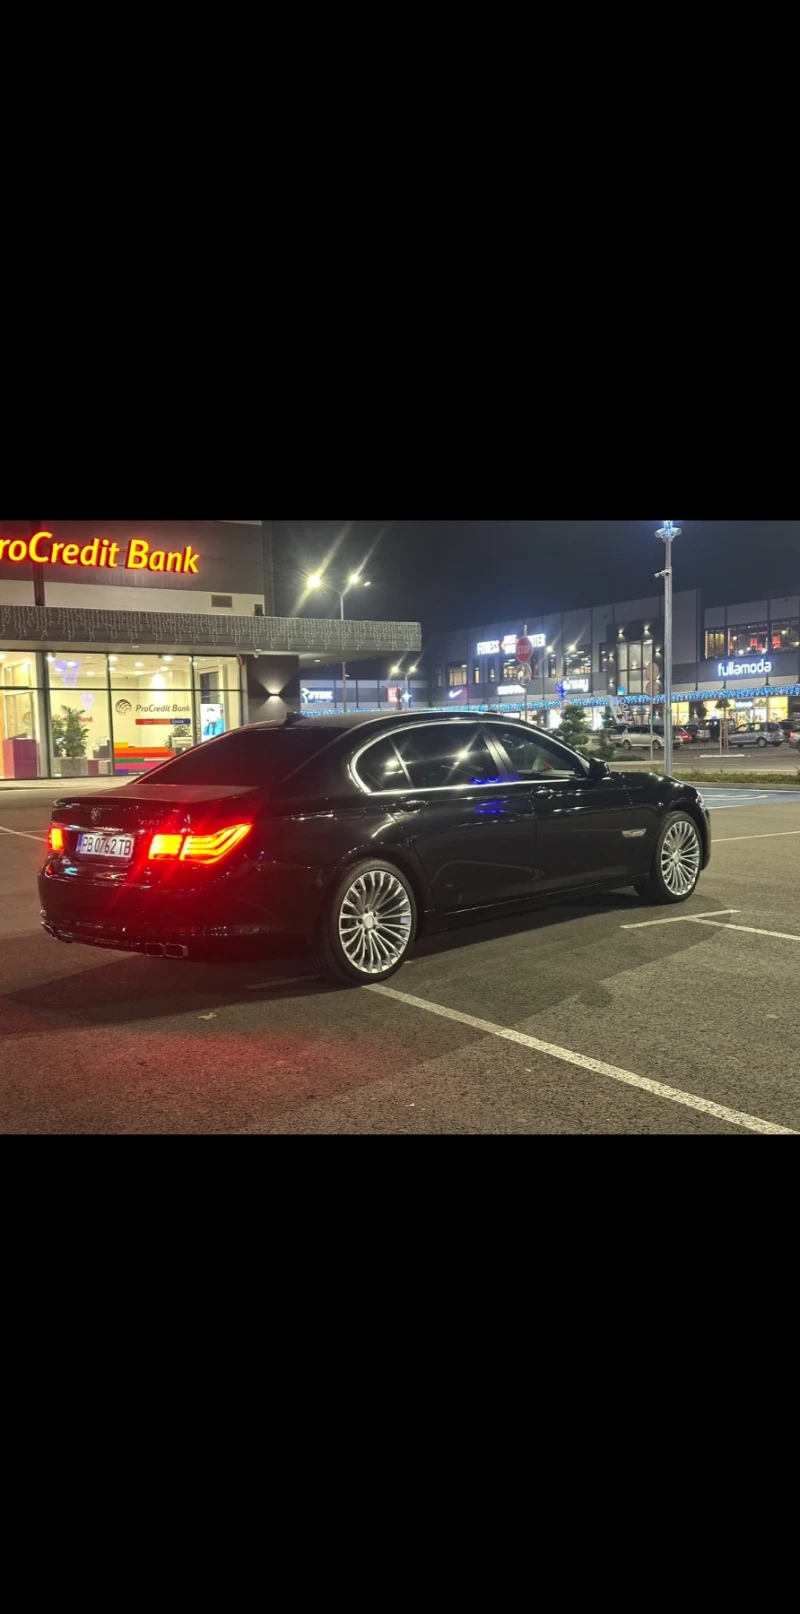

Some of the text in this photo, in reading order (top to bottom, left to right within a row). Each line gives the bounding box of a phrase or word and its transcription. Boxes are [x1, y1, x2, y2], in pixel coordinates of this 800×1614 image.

[0, 531, 200, 573] roCredit Bank
[517, 645, 531, 655] STOP
[717, 658, 772, 677] fullamoda
[562, 677, 589, 692] sinsay
[135, 704, 190, 712] ProCredit Bank
[83, 836, 131, 856] PB 0762 TB
